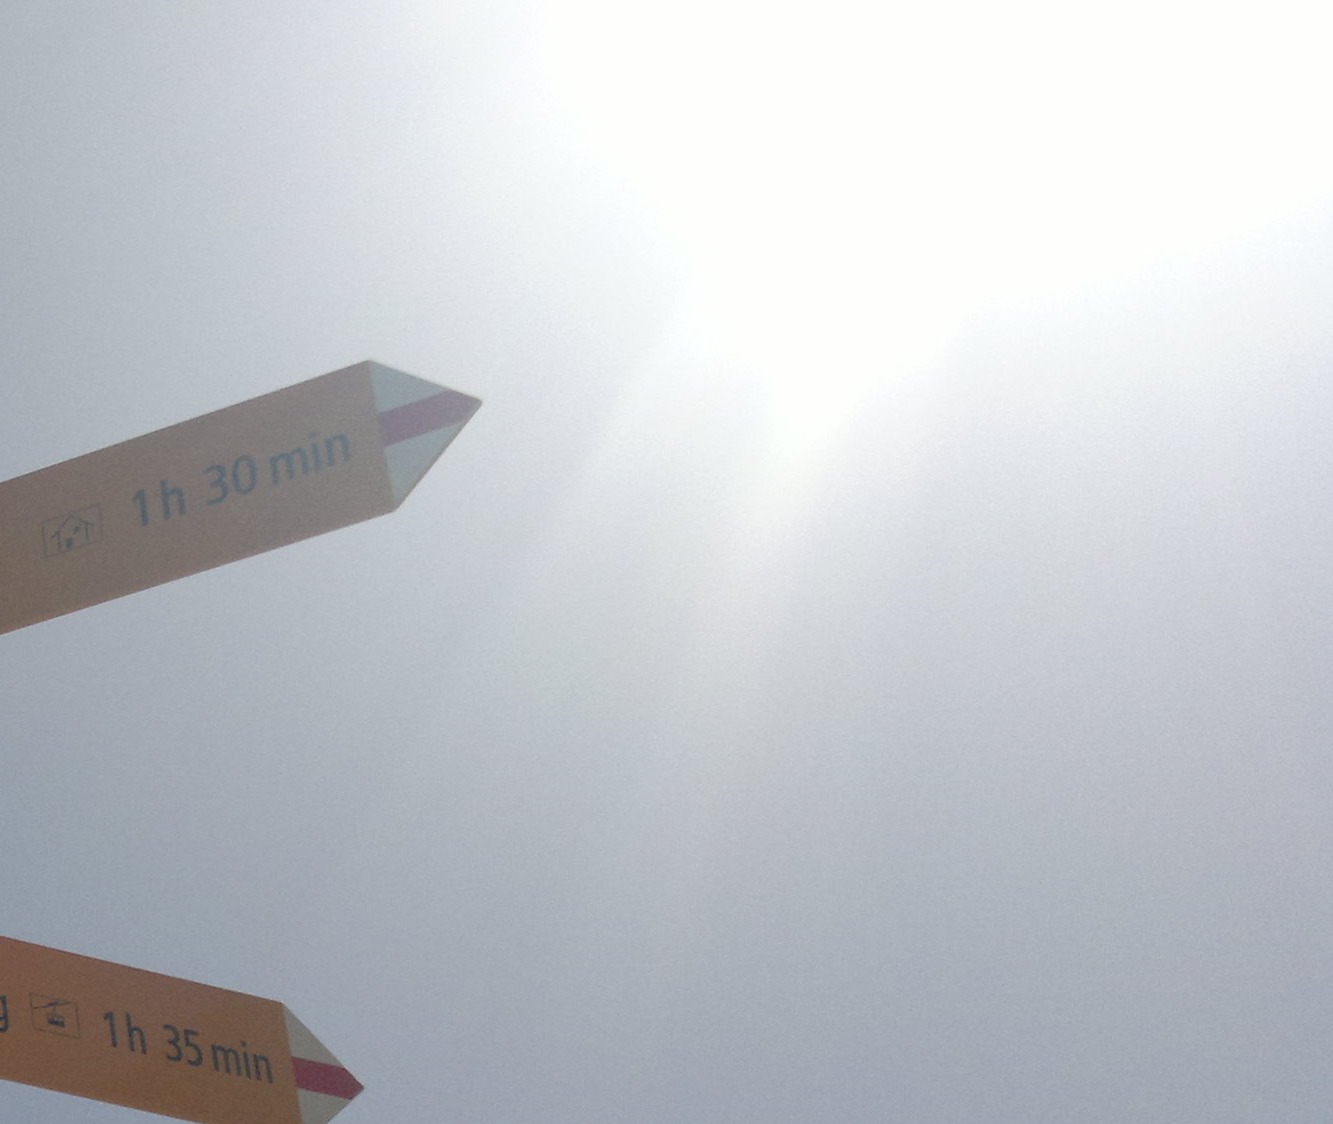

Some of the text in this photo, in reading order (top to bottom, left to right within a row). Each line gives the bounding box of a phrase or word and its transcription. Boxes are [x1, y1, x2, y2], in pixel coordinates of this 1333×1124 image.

[205, 455, 259, 506] 30
[270, 430, 351, 486] min
[164, 1024, 204, 1067] 35
[211, 1039, 274, 1084] min
